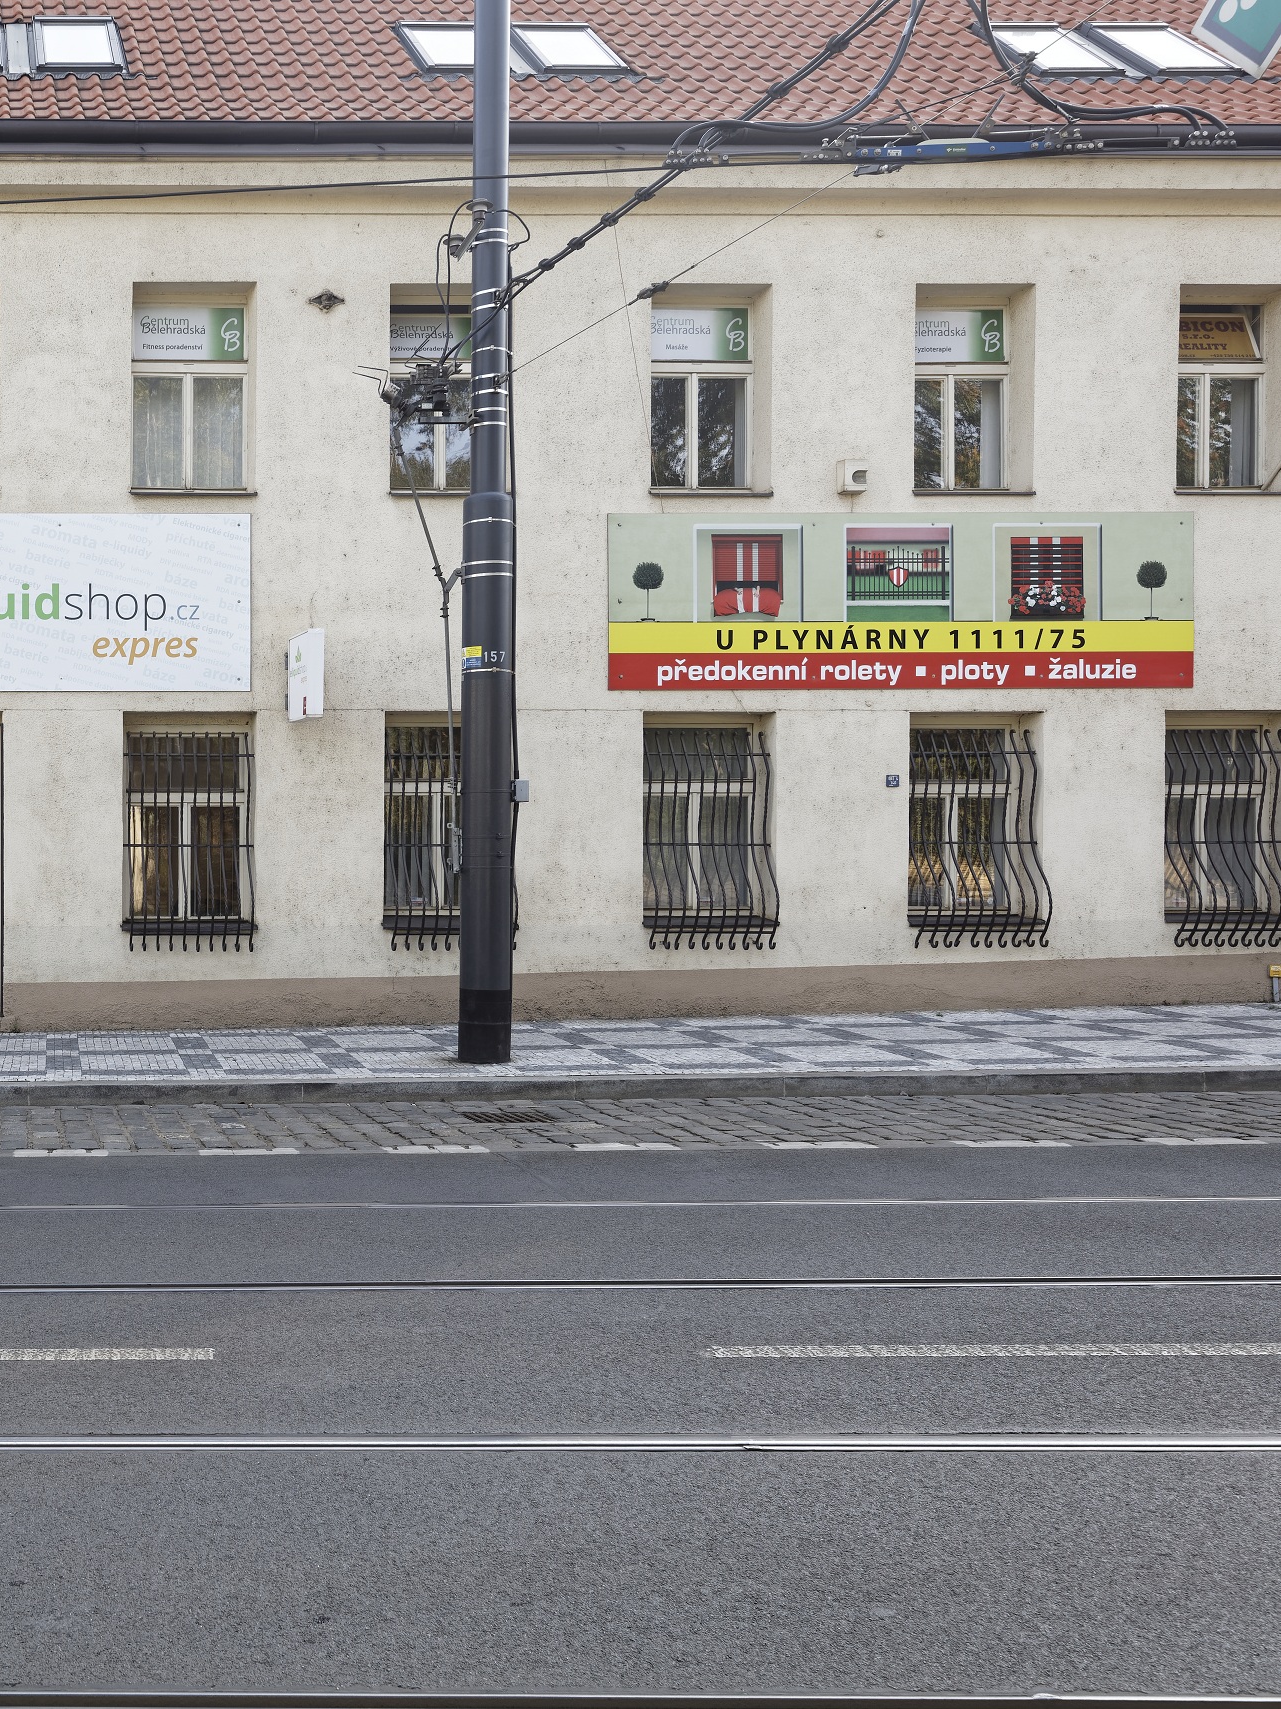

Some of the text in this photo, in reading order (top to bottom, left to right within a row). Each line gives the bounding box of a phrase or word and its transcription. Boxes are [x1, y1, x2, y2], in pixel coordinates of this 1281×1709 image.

[140, 316, 189, 325] Centrum
[141, 323, 206, 335] Bělehradská
[665, 343, 688, 351] Masáže
[172, 517, 222, 535] Elektronické
[31, 523, 98, 549] aromata
[165, 531, 217, 552] příchutě
[25, 548, 71, 569] baterie
[102, 539, 153, 560] e-liquidy
[8, 561, 35, 576] vata
[79, 551, 126, 570] nabíječky
[9, 575, 42, 591] cigaety
[164, 570, 198, 590] báze
[201, 612, 228, 626] vata
[9, 620, 76, 644] aromata
[200, 625, 234, 640] cigarety
[716, 625, 1087, 651] U PLYNÁRNY 1111/75
[4, 643, 50, 665] baterie
[92, 637, 199, 665] expres
[483, 650, 506, 663] 157
[142, 665, 176, 684] báze
[657, 656, 1137, 686] předokenní rolety ploty žaluzie
